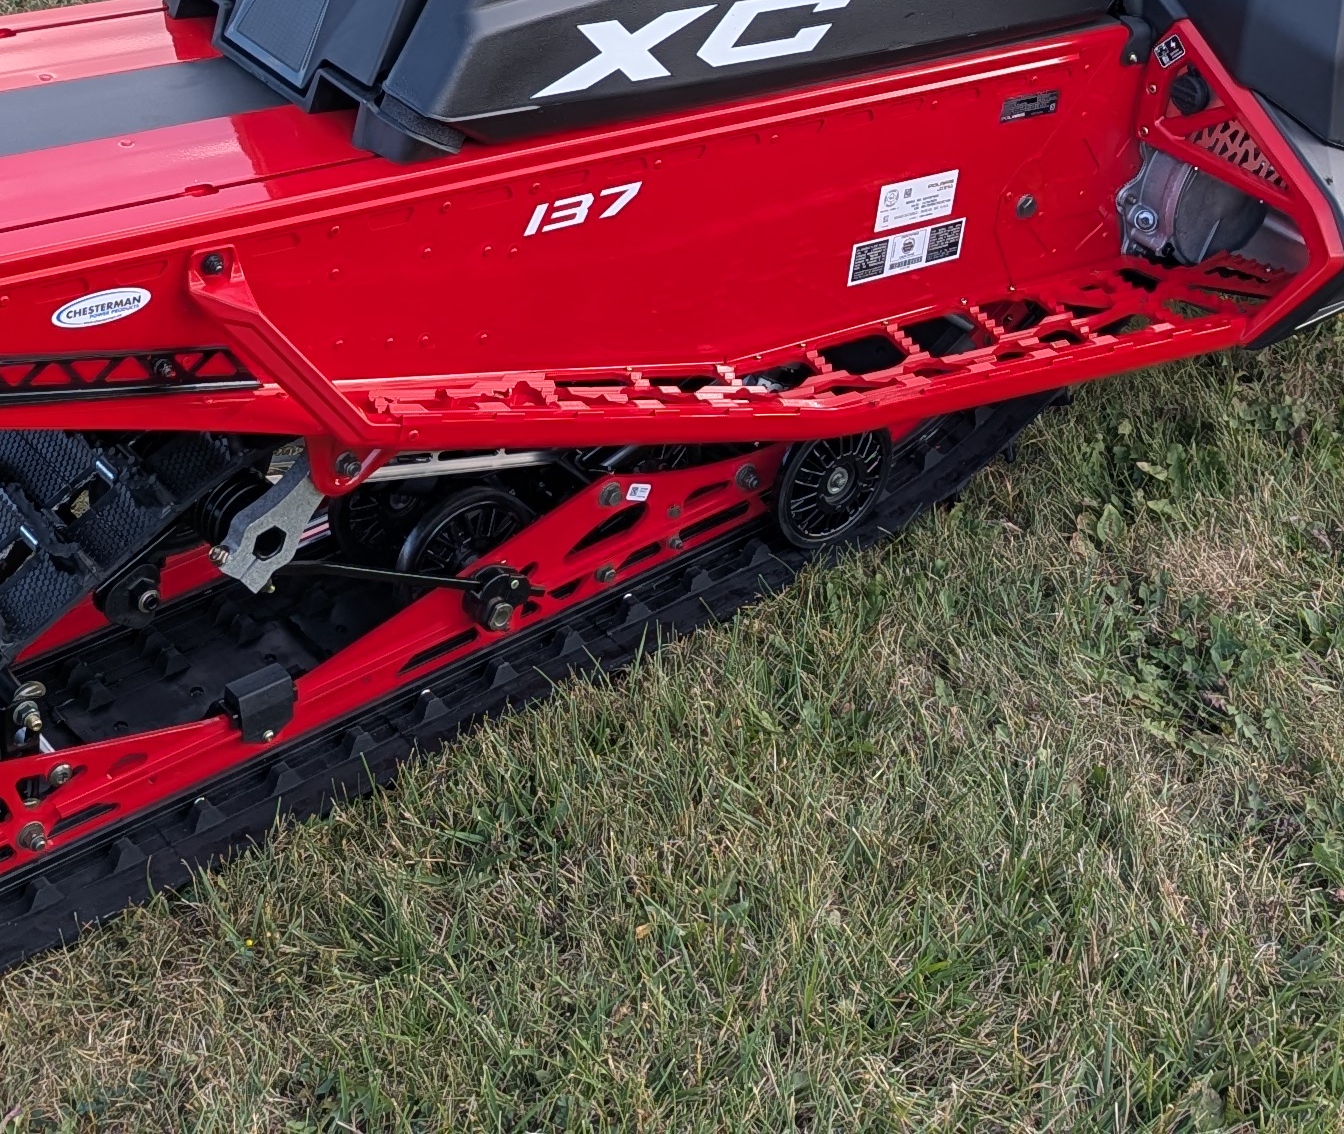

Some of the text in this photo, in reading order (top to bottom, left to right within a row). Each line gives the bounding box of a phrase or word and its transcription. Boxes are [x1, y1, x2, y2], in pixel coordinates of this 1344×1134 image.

[523, 180, 643, 237] 137
[66, 294, 142, 320] CHESTERMAN
[89, 310, 110, 320] POWER
[111, 303, 140, 315] PRODUCTS
